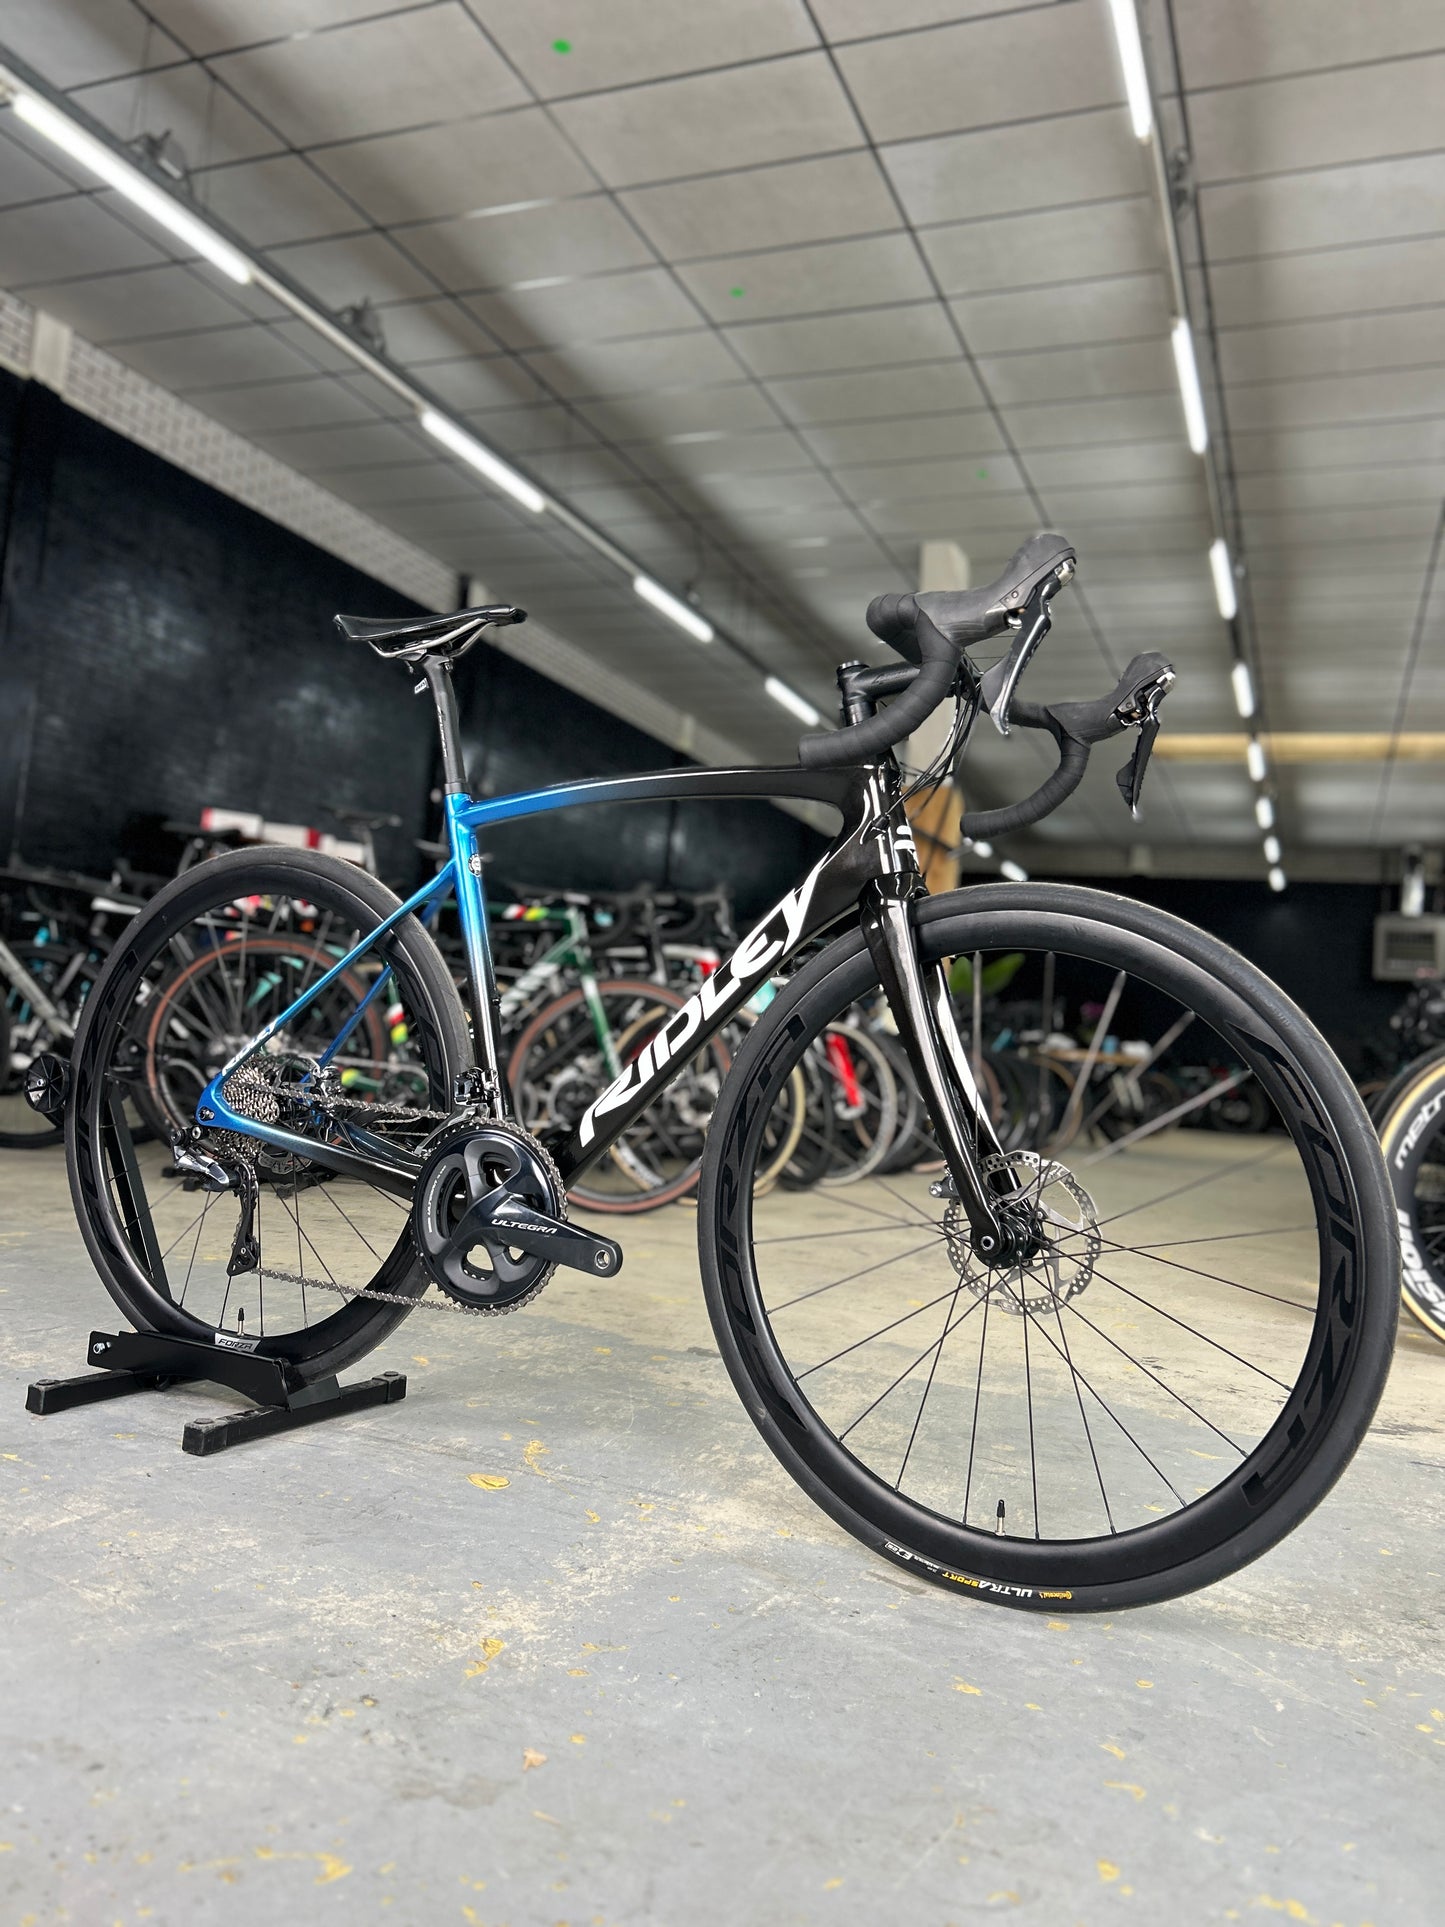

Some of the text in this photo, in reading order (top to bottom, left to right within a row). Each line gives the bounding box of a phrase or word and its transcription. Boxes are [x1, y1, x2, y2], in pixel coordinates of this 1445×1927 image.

[579, 851, 829, 1147] RIDLEY
[218, 1338, 253, 1350] FORZA
[491, 1218, 558, 1234] ULTEGRA
[717, 1013, 809, 1431] FORZA
[1225, 1021, 1359, 1508] FORZA
